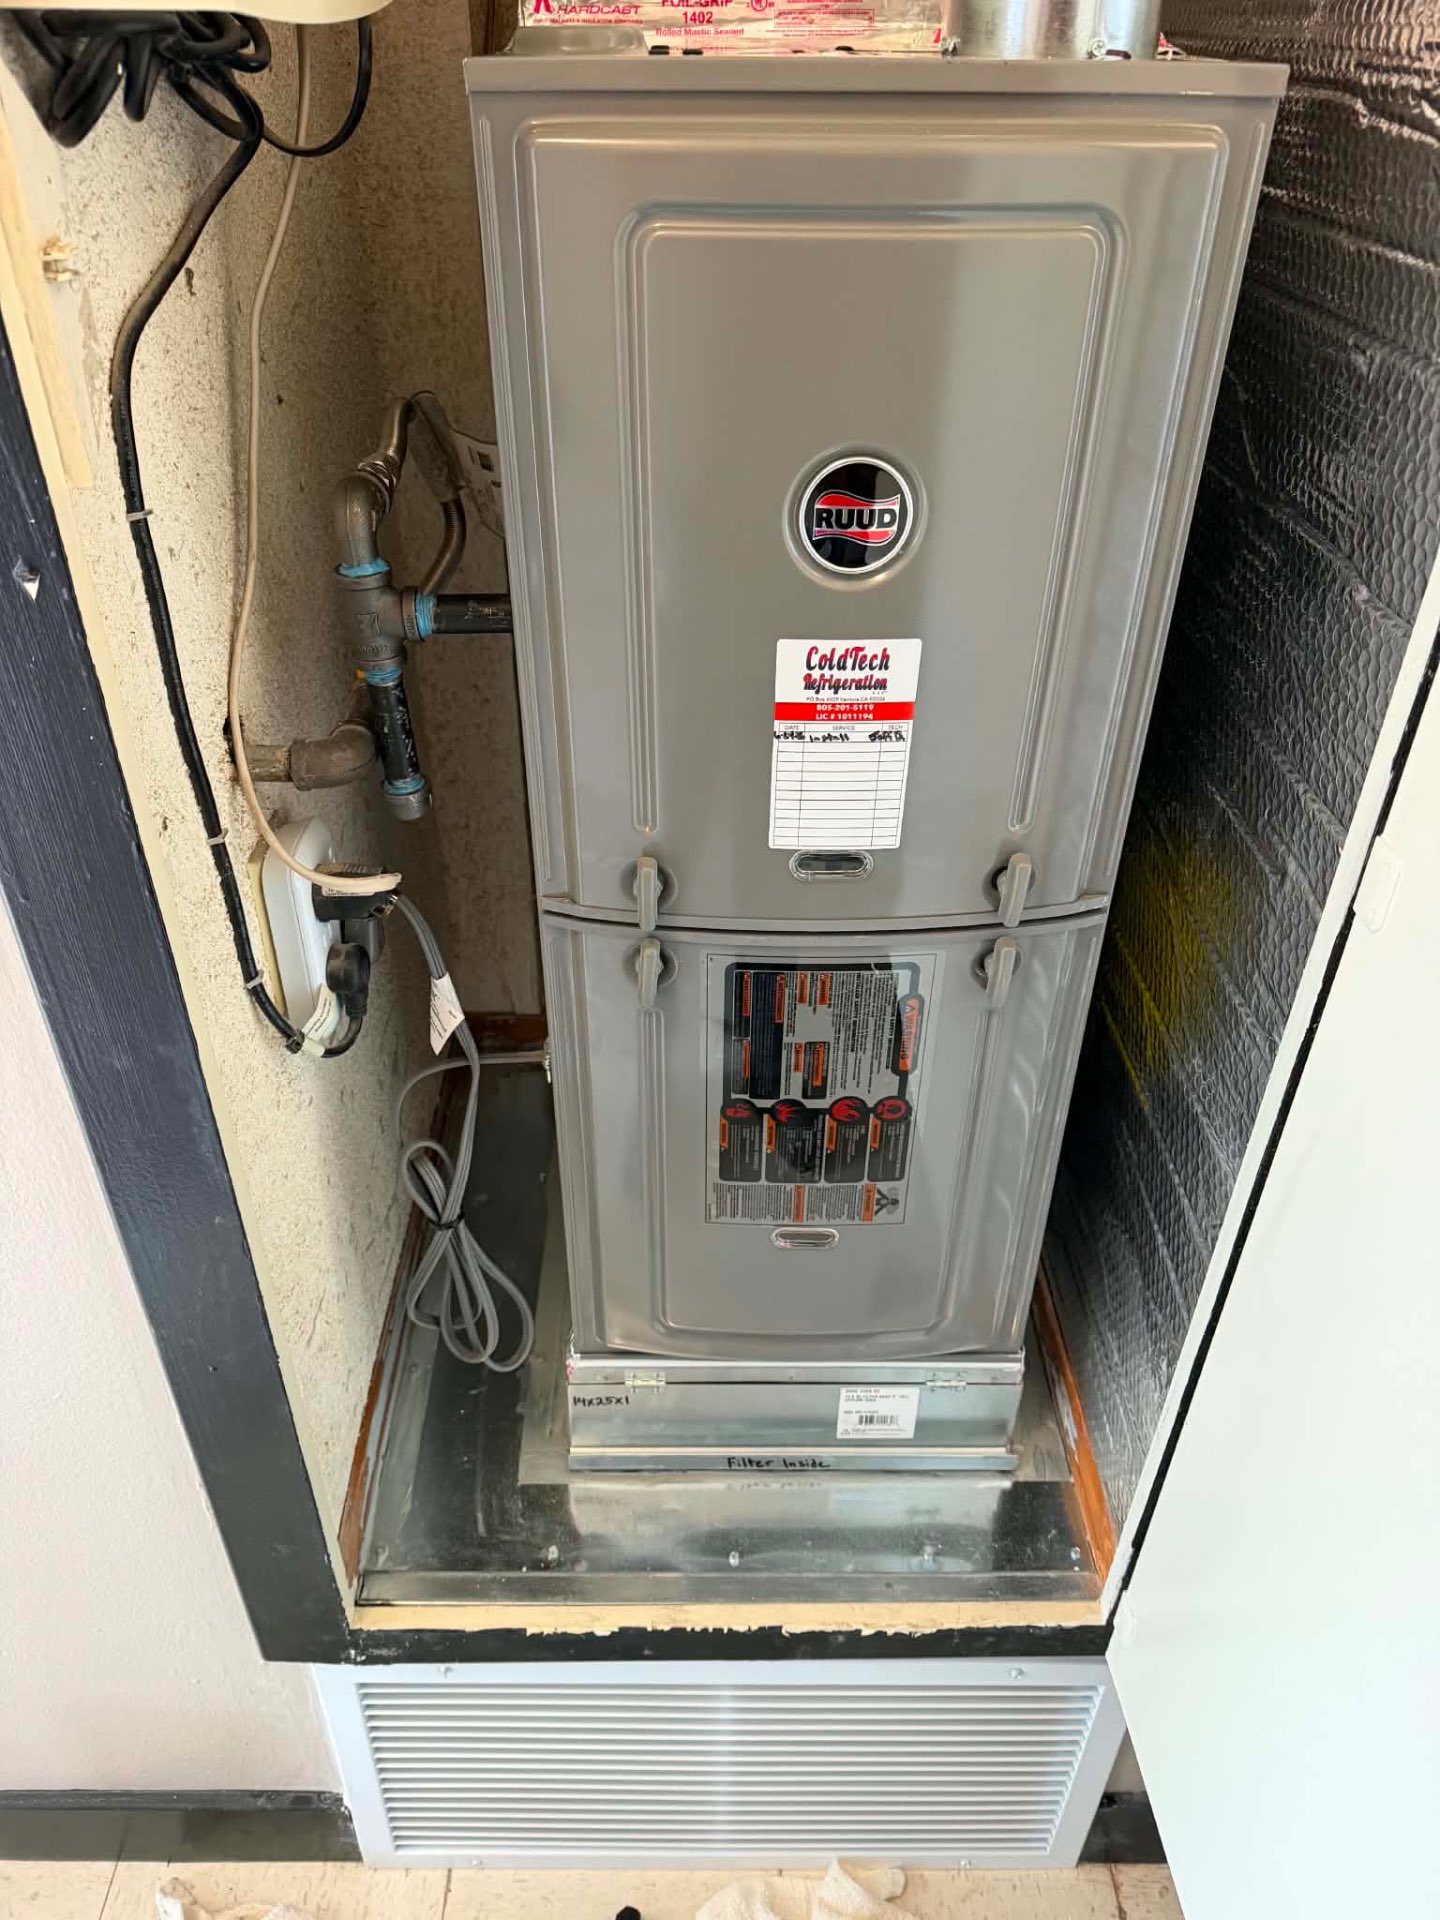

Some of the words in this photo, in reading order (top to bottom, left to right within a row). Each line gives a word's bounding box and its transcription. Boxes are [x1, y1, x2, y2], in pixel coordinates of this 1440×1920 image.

[556, 5, 640, 14] HARDCAST
[682, 11, 713, 24] 1402
[815, 508, 898, 530] RUUD
[805, 646, 890, 671] ColdTech
[803, 673, 888, 695] Refrigeration
[727, 1457, 774, 1468] Filter
[782, 1457, 831, 1468] Inside
